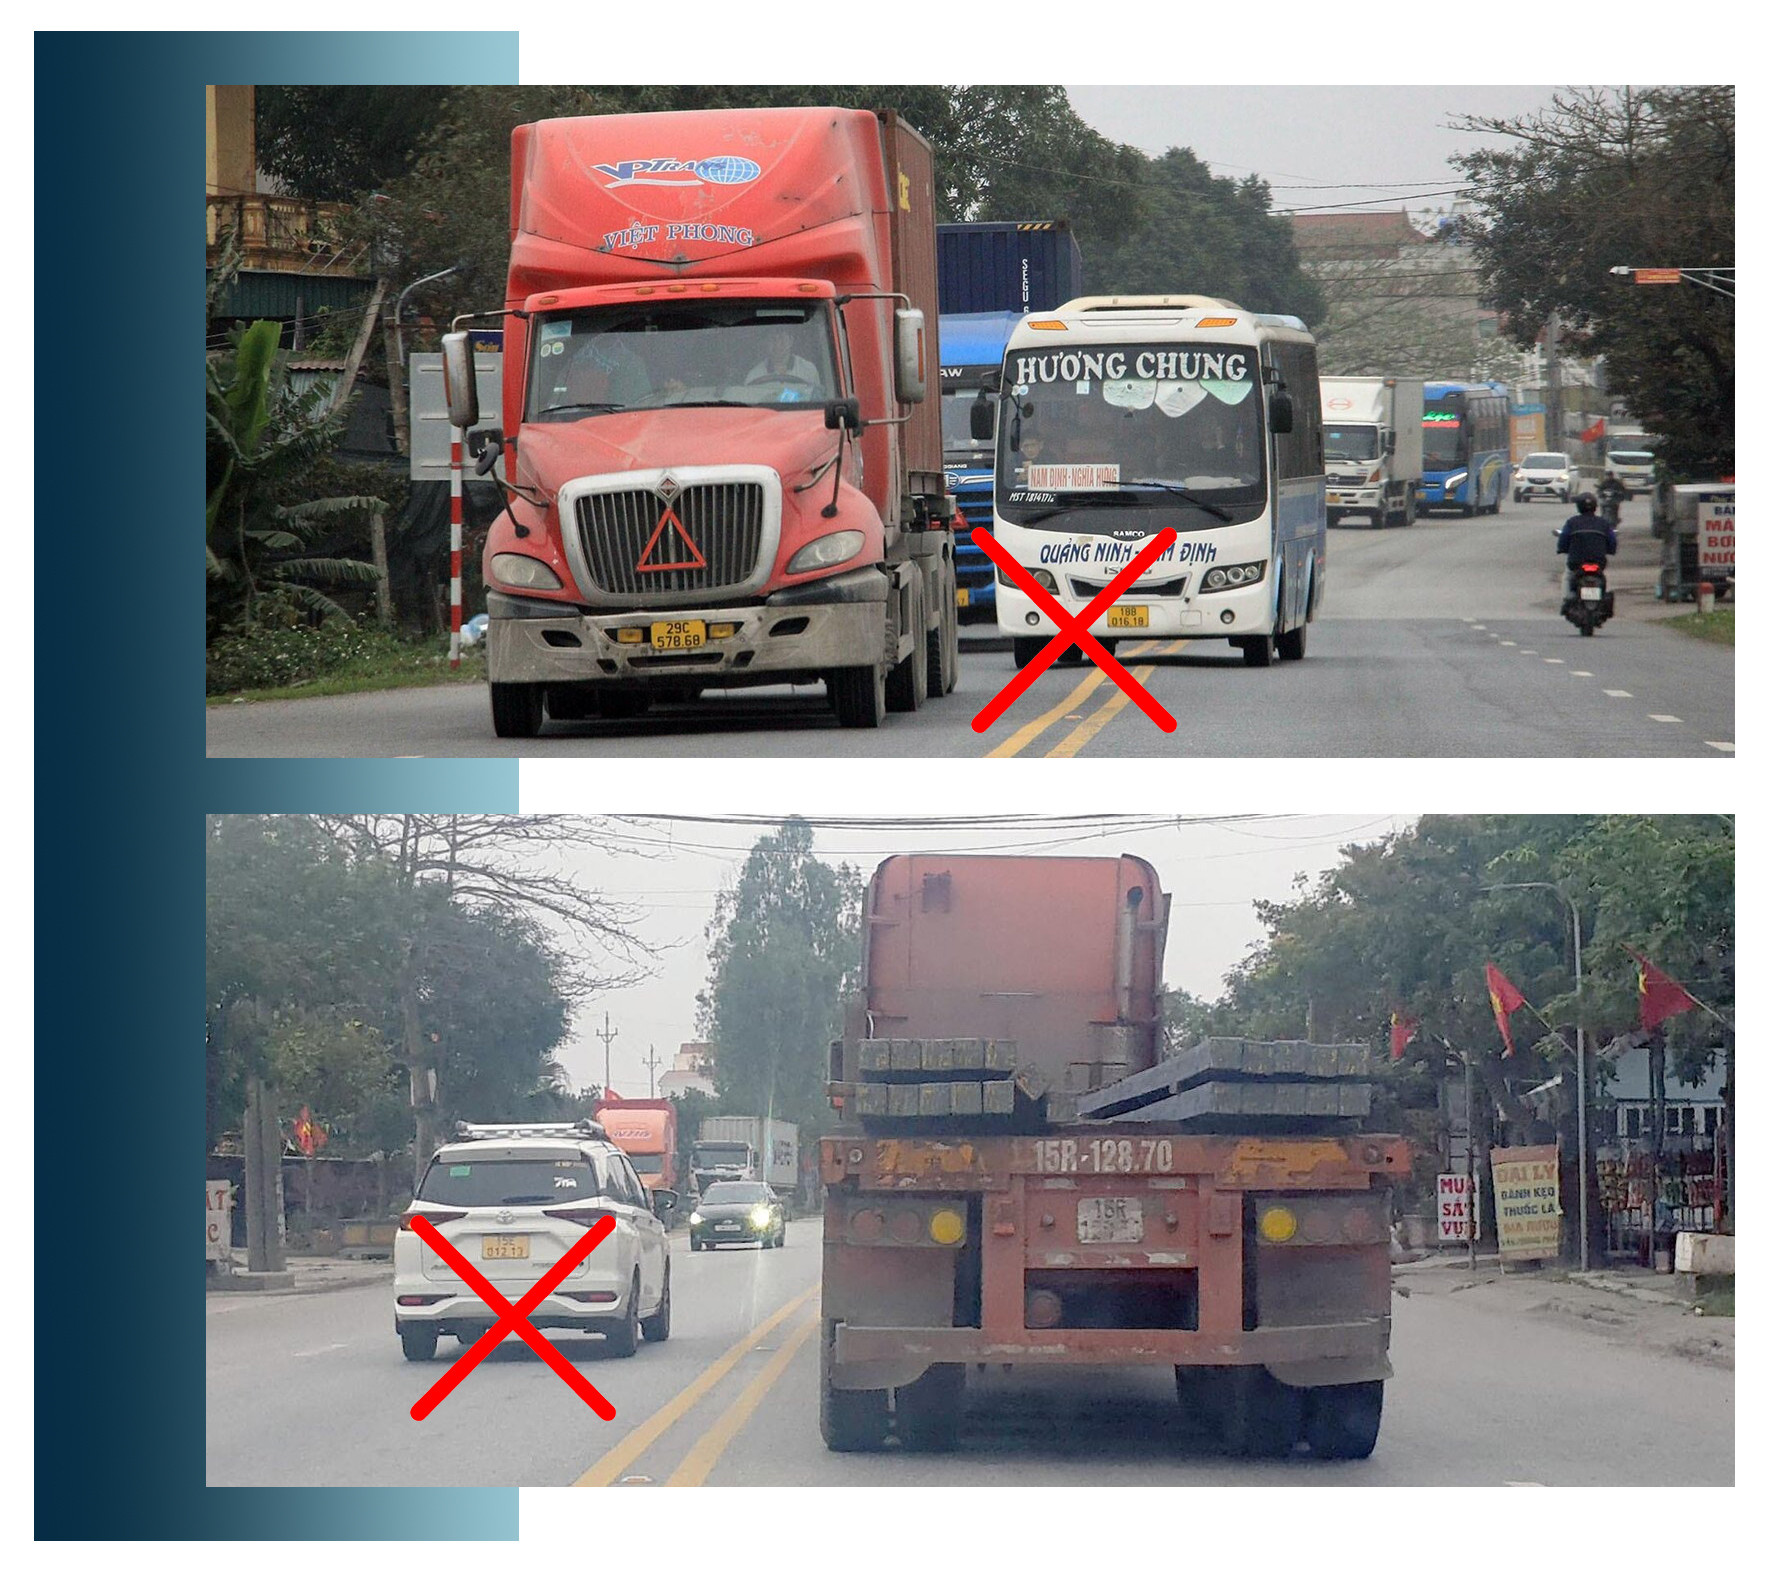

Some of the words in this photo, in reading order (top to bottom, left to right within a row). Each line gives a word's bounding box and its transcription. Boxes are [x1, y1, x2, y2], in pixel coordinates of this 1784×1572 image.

[603, 221, 659, 250] VIỆT
[666, 223, 753, 246] PHONG
[1016, 350, 1127, 385] HƯƠNG
[1135, 351, 1248, 381] CHUNG
[1030, 466, 1049, 487] NAM
[1071, 465, 1094, 487] NGHĨA
[1009, 492, 1026, 502] MST
[1040, 538, 1092, 565] QUẢNG
[1094, 542, 1134, 564] NINH
[1179, 543, 1218, 567] ĐỊNH
[666, 622, 690, 634] 29C
[657, 635, 700, 648] 578.68
